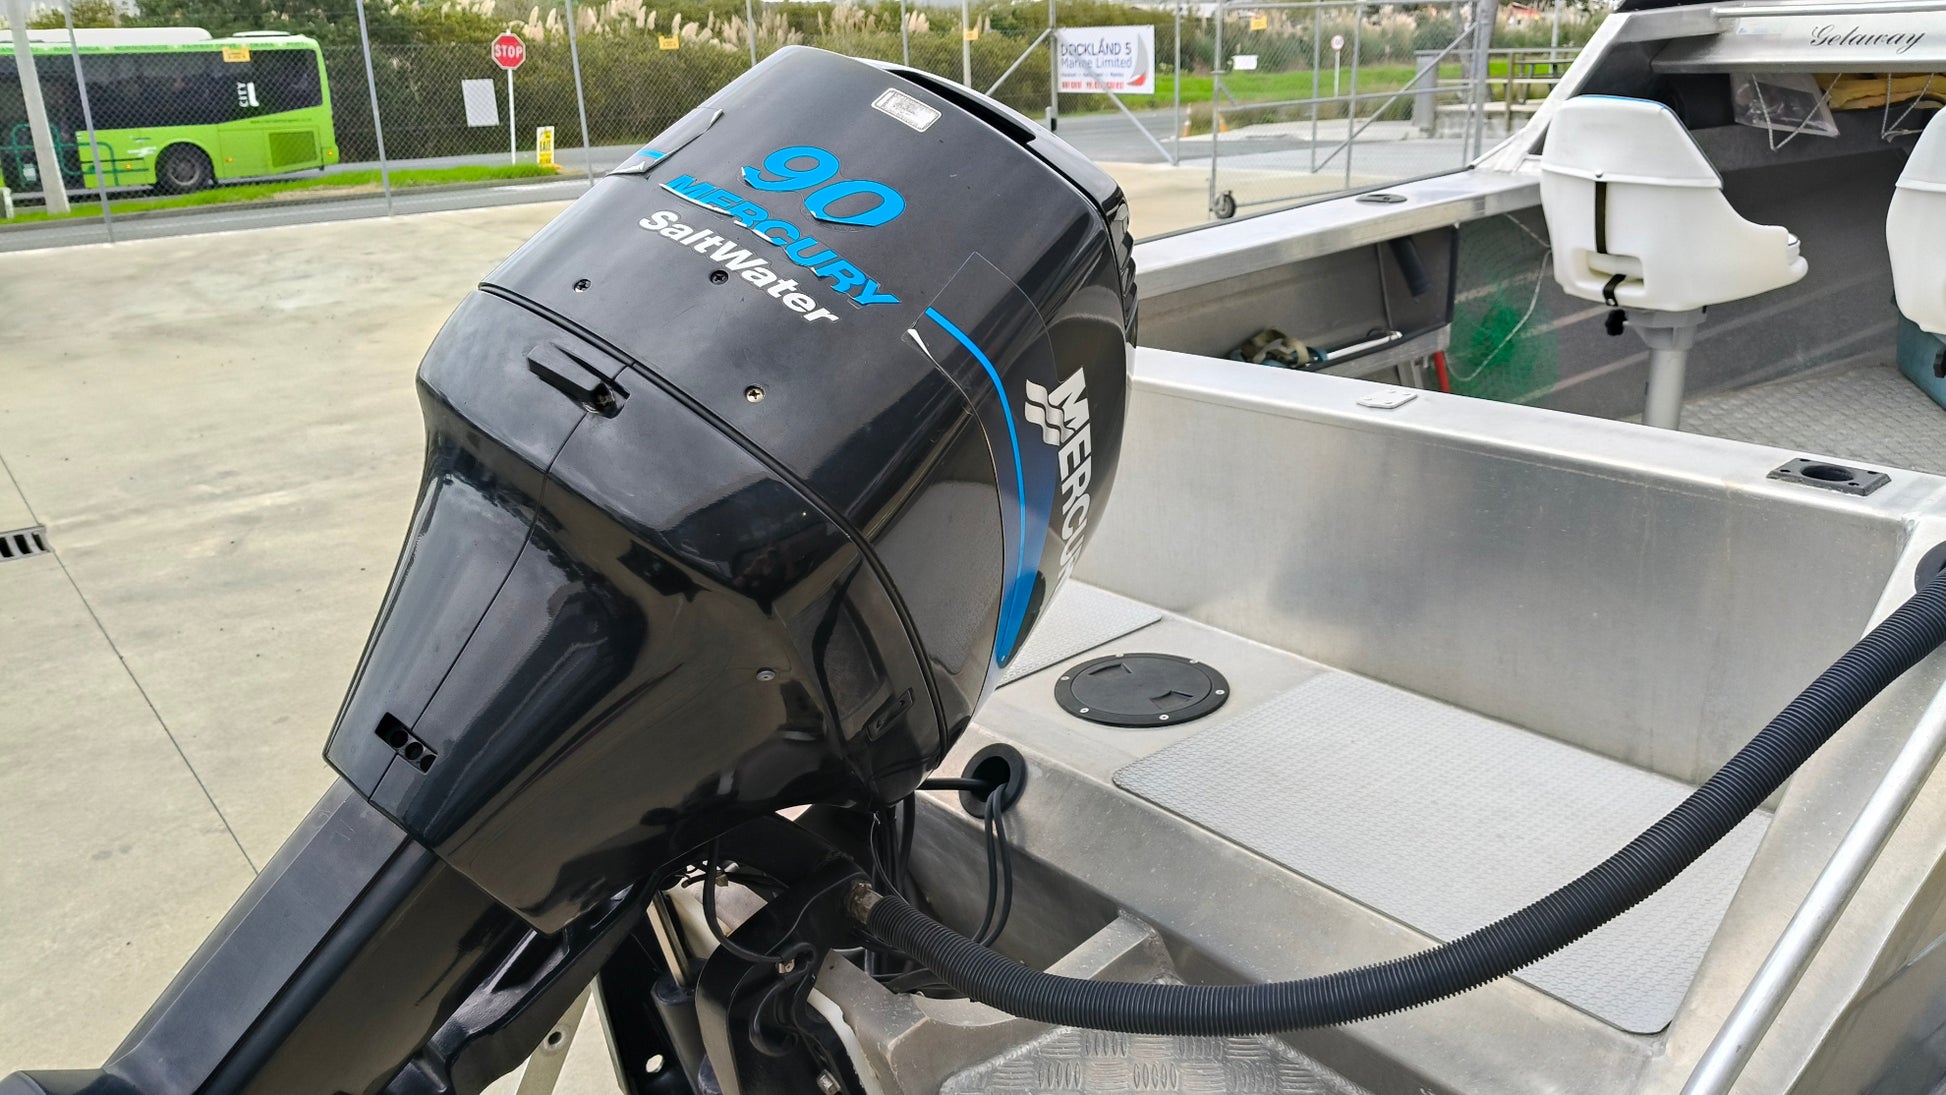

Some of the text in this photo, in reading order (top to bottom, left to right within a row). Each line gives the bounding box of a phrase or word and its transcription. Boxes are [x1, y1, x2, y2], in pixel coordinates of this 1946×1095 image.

[494, 45, 523, 58] STOP
[1061, 41, 1132, 56] DOCKLAND 5
[1097, 57, 1132, 69] Limited
[1810, 24, 1926, 54] Getaway
[741, 146, 905, 227] 90
[639, 211, 839, 322] SaltWater
[660, 175, 900, 305] MERCURY
[1048, 367, 1092, 590] MERCUR
